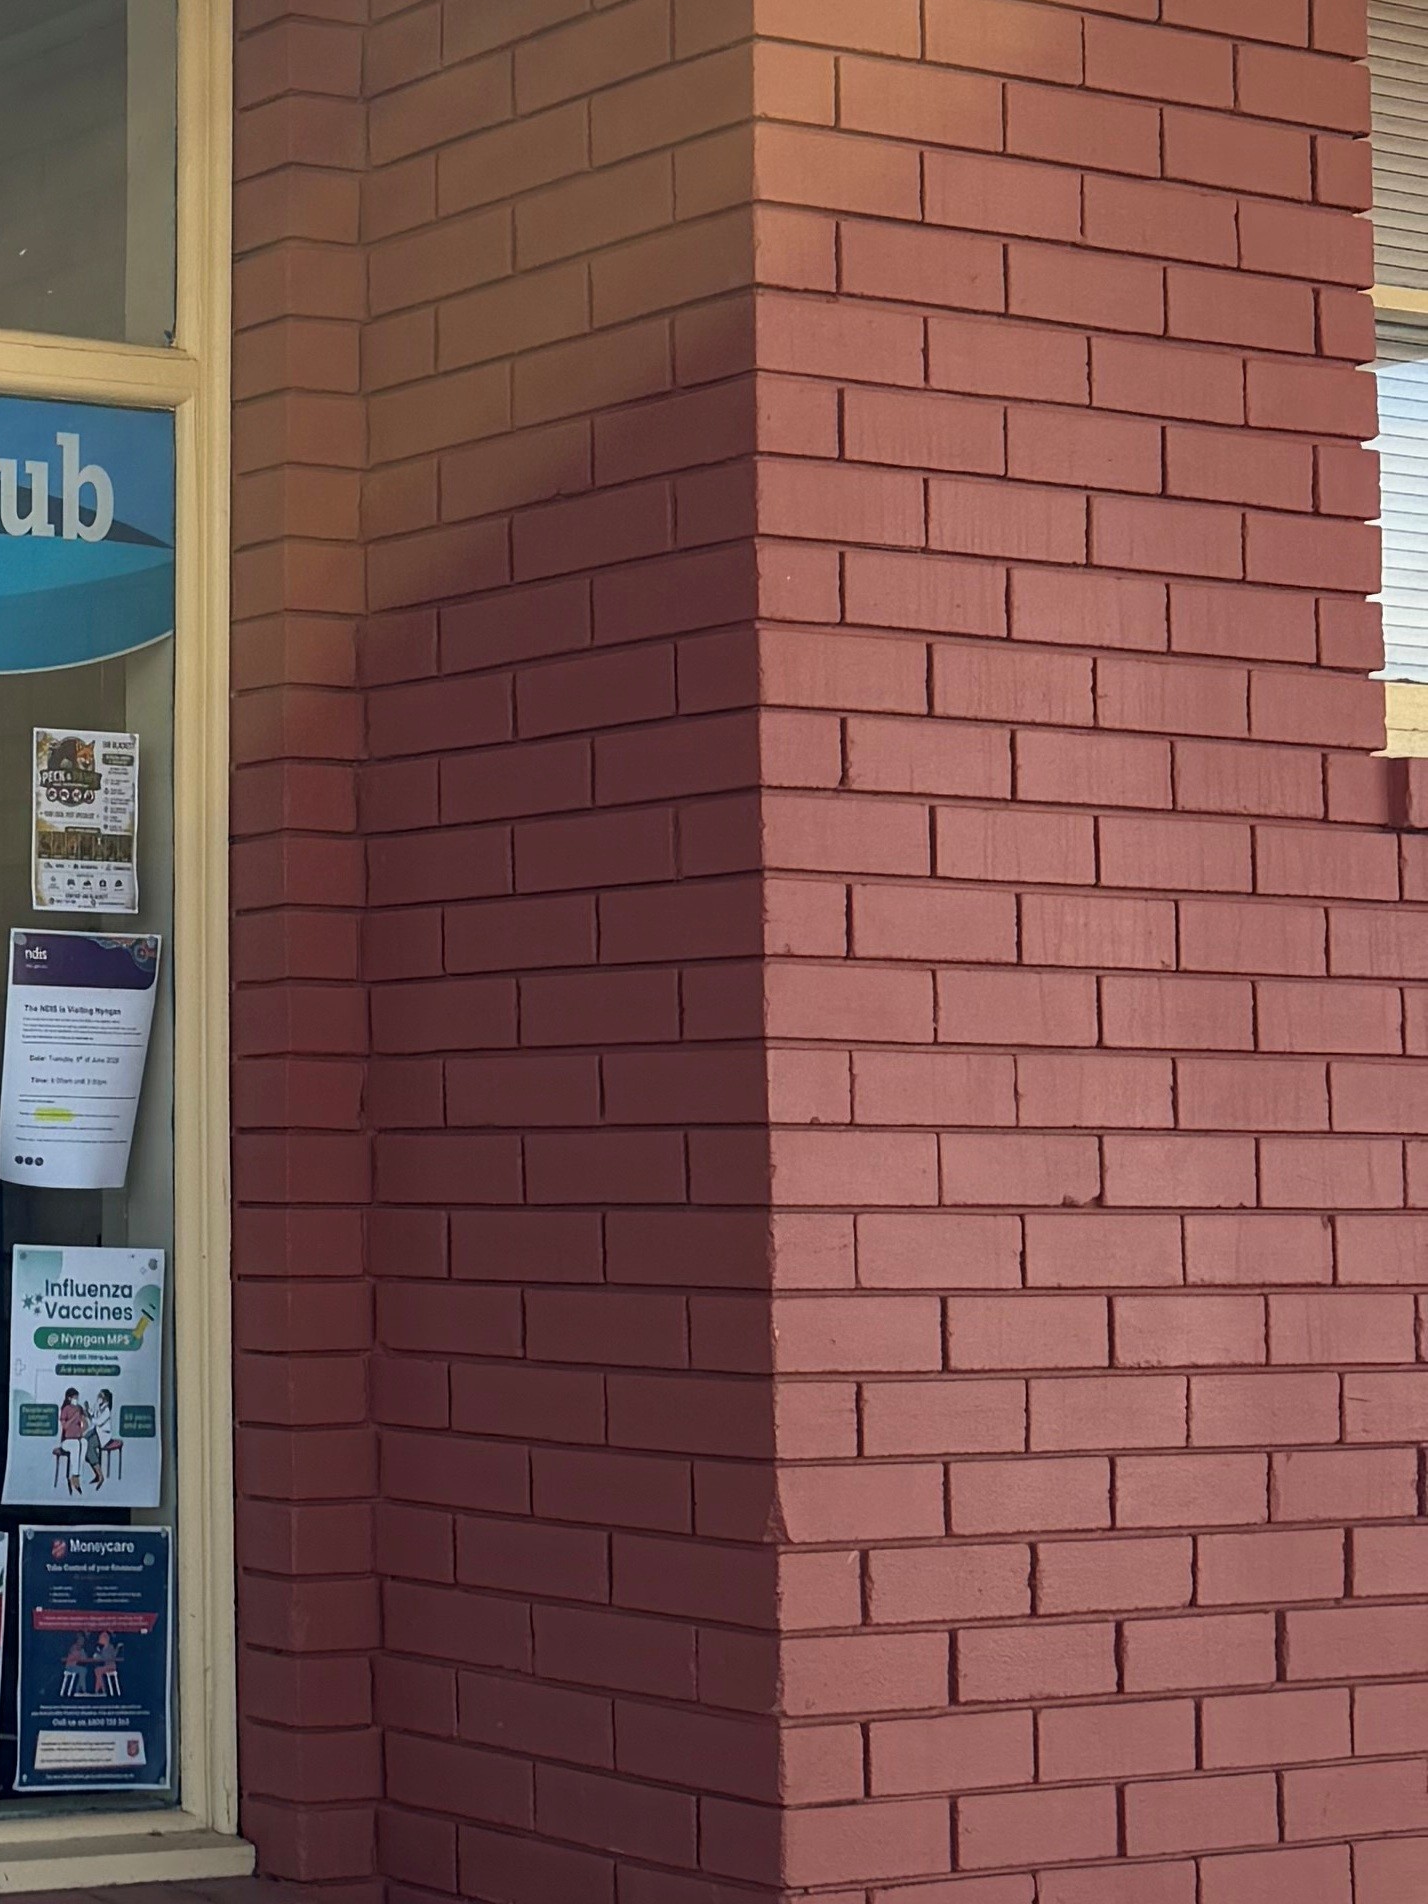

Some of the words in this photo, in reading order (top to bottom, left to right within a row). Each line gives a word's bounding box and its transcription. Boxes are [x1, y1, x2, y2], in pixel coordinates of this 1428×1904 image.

[25, 946, 48, 960] ndis
[45, 1278, 133, 1299] Influenza
[45, 1301, 133, 1320] Vaccines
[61, 1333, 105, 1348] Nyngan
[70, 1538, 135, 1556] Moneycare
